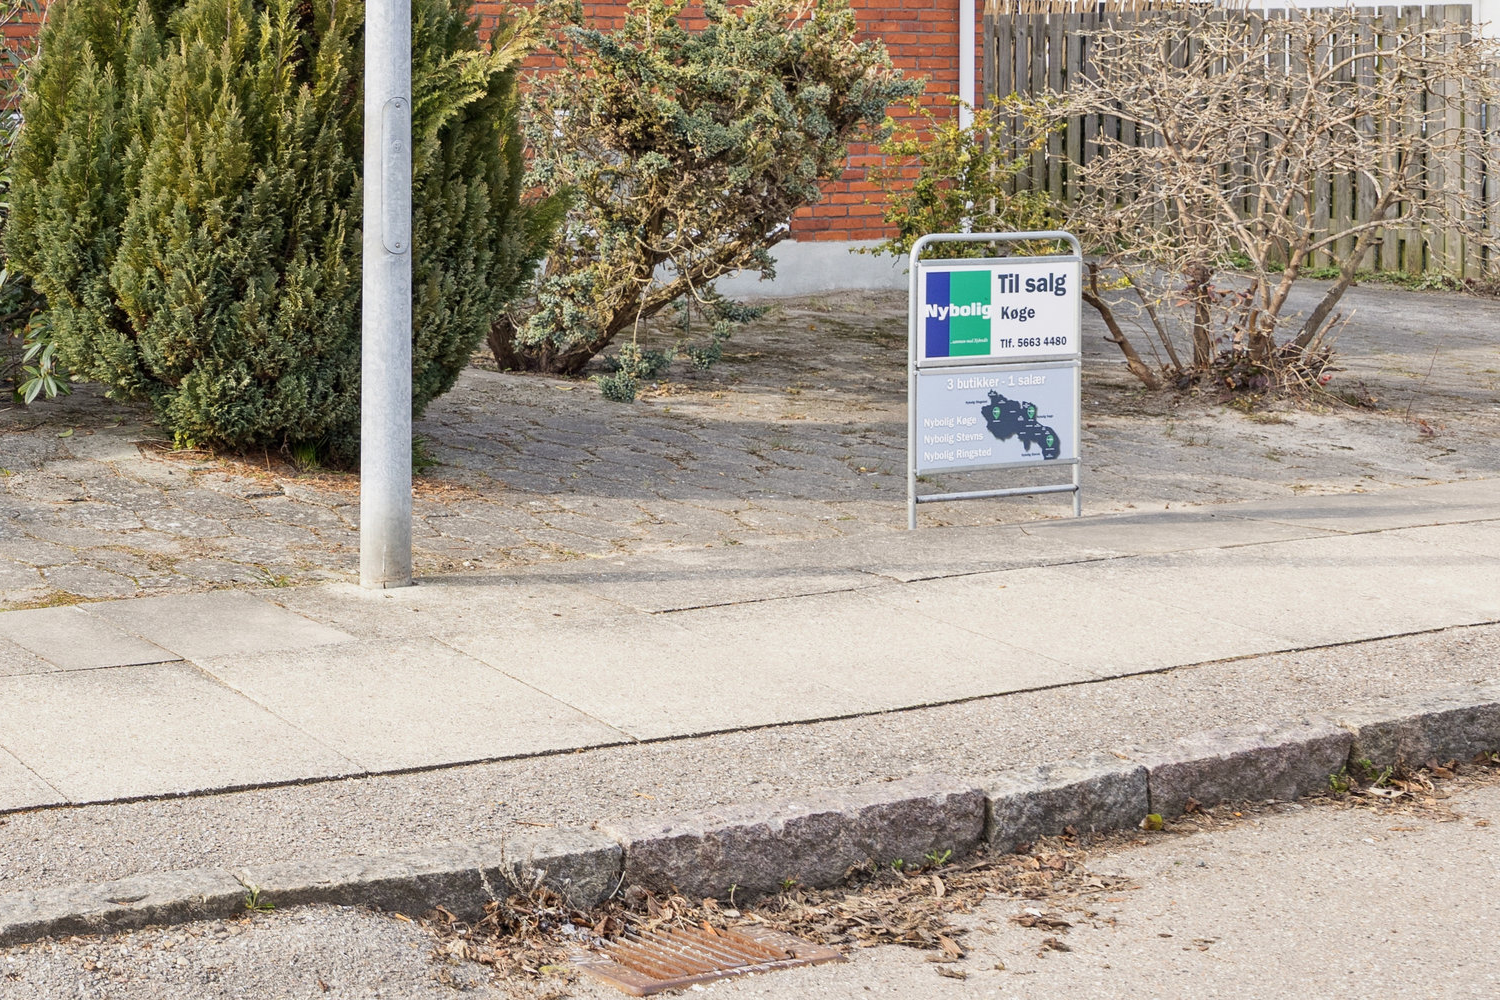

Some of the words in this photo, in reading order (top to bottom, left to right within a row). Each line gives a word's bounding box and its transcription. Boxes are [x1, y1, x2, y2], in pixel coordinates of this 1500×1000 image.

[998, 273, 1019, 294] Til
[1025, 272, 1067, 297] salg
[925, 302, 992, 321] Nybolig
[1001, 306, 1036, 322] Køge
[1000, 338, 1015, 348] Tlf.
[1017, 337, 1041, 348] 5663
[1043, 336, 1067, 347] 4480
[946, 378, 954, 390] 3
[957, 376, 1000, 389] butikker
[1008, 376, 1015, 387] 1
[1017, 374, 1046, 386] salær
[923, 417, 955, 429] Nybolig
[956, 415, 977, 428] Køge
[923, 434, 955, 446] Nybolig
[956, 432, 984, 443] Stevns
[923, 451, 955, 463] Nybolig
[956, 448, 992, 460] Ringsted
